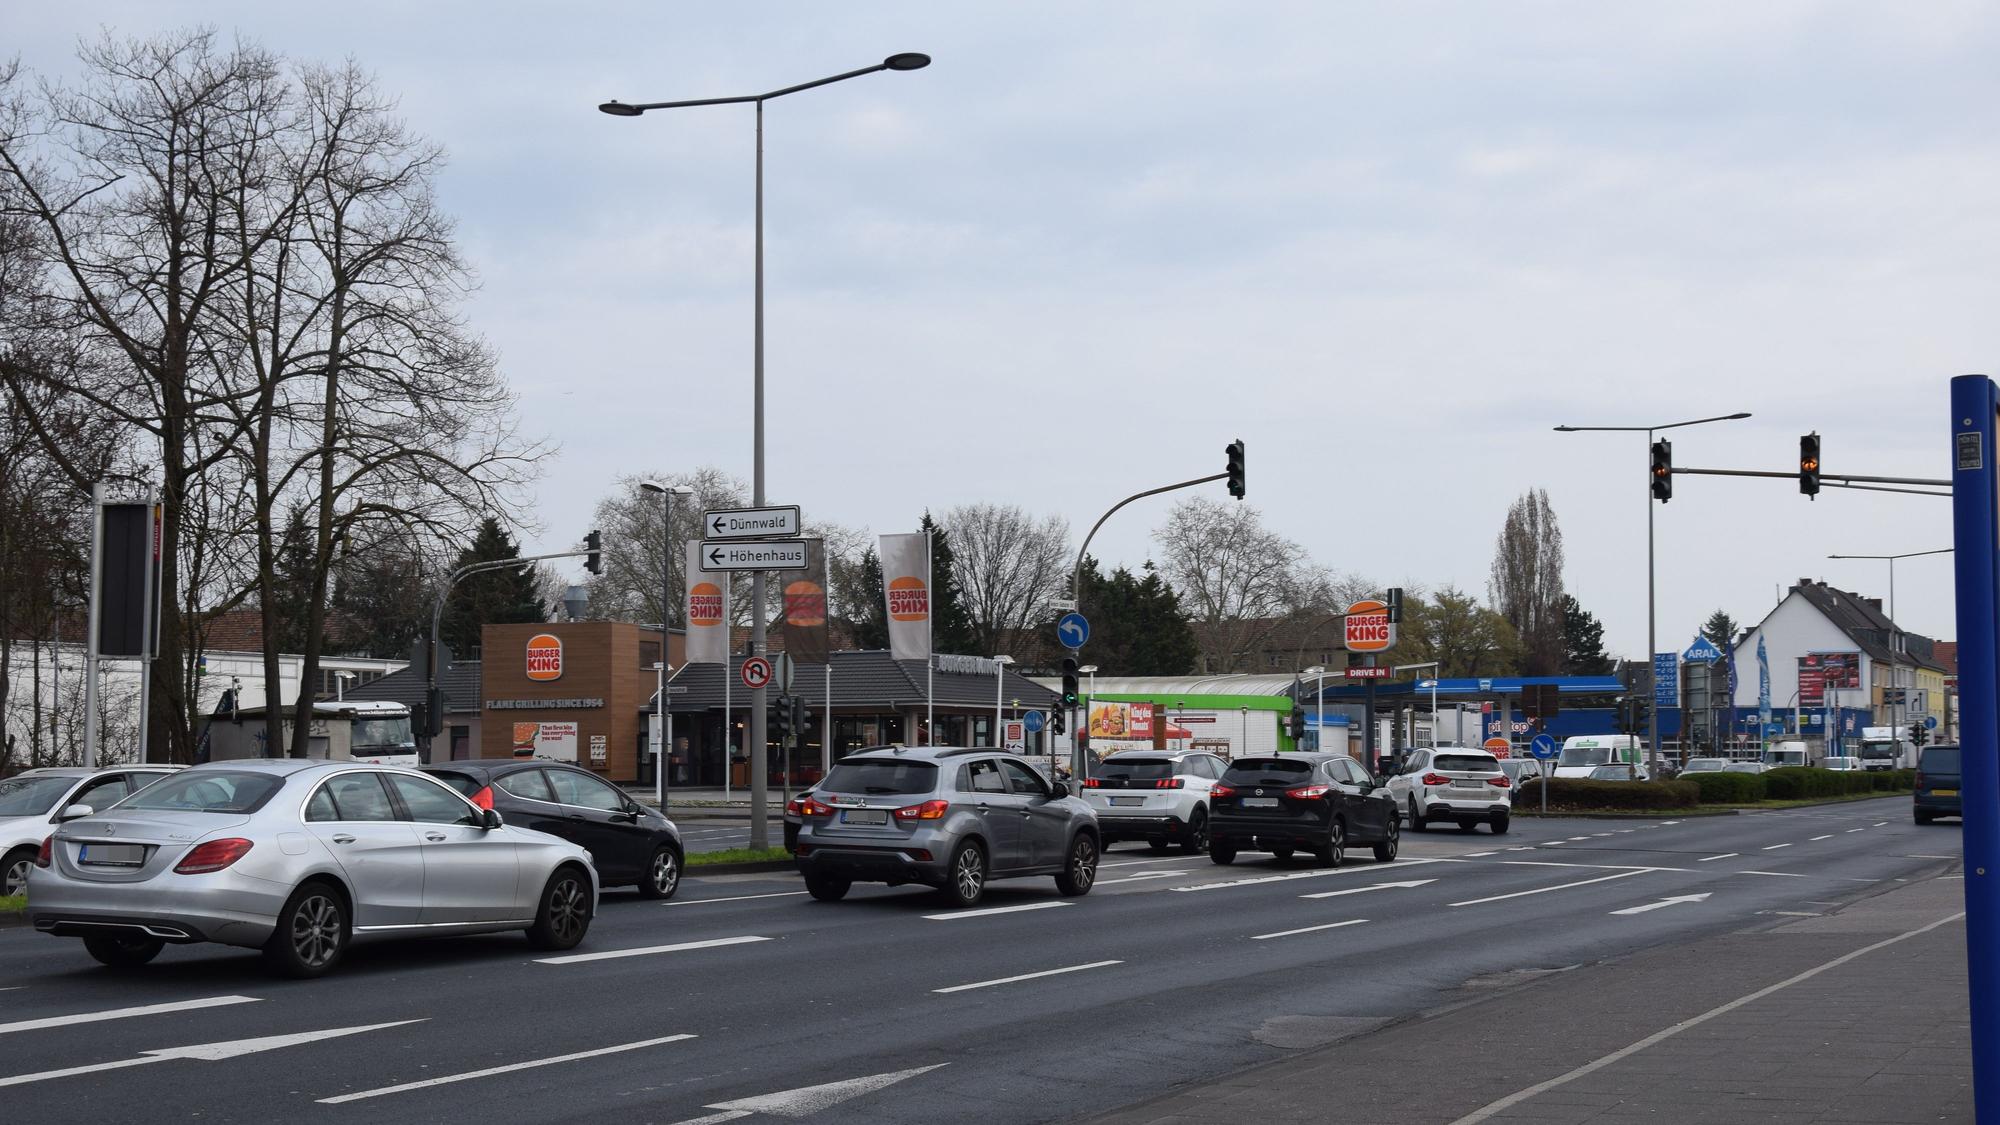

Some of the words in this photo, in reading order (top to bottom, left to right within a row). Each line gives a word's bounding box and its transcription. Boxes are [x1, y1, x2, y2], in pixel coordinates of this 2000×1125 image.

[730, 516, 785, 530] Dünnwald
[730, 549, 802, 562] Höhenhaus
[1346, 616, 1389, 626] BURGER
[1346, 626, 1389, 641] KING
[527, 649, 561, 658] BURGER
[1687, 649, 1717, 659] ARAL
[527, 658, 561, 671] KING
[1350, 669, 1374, 677] DRIVE
[486, 700, 514, 709] FLAME
[515, 699, 556, 709] GRILLING
[556, 699, 581, 708] SINCE
[582, 698, 604, 708] 1954
